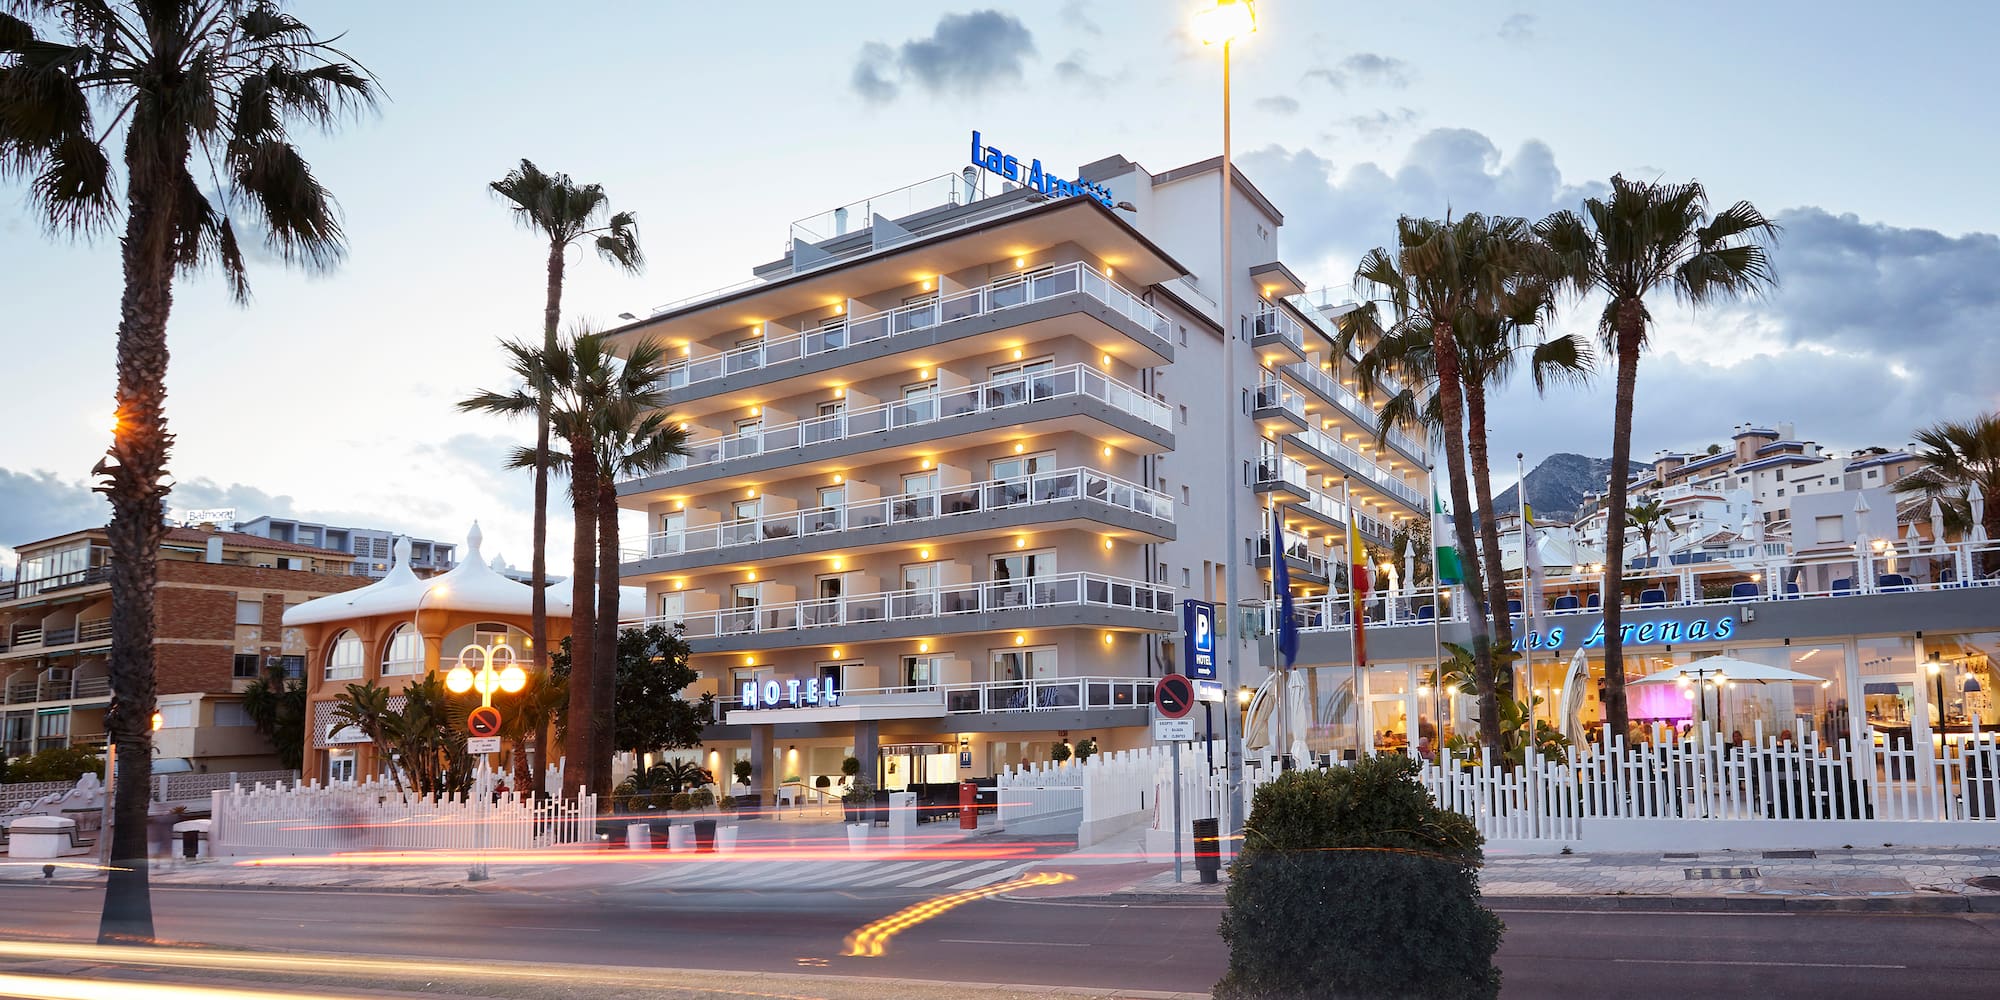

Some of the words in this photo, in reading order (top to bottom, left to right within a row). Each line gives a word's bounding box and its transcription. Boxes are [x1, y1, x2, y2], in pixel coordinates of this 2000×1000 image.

[972, 130, 1018, 181] Las
[1198, 613, 1209, 644] P
[1511, 621, 1564, 650] as
[1196, 654, 1213, 666] HOTEL
[742, 676, 838, 707] HOTEL
